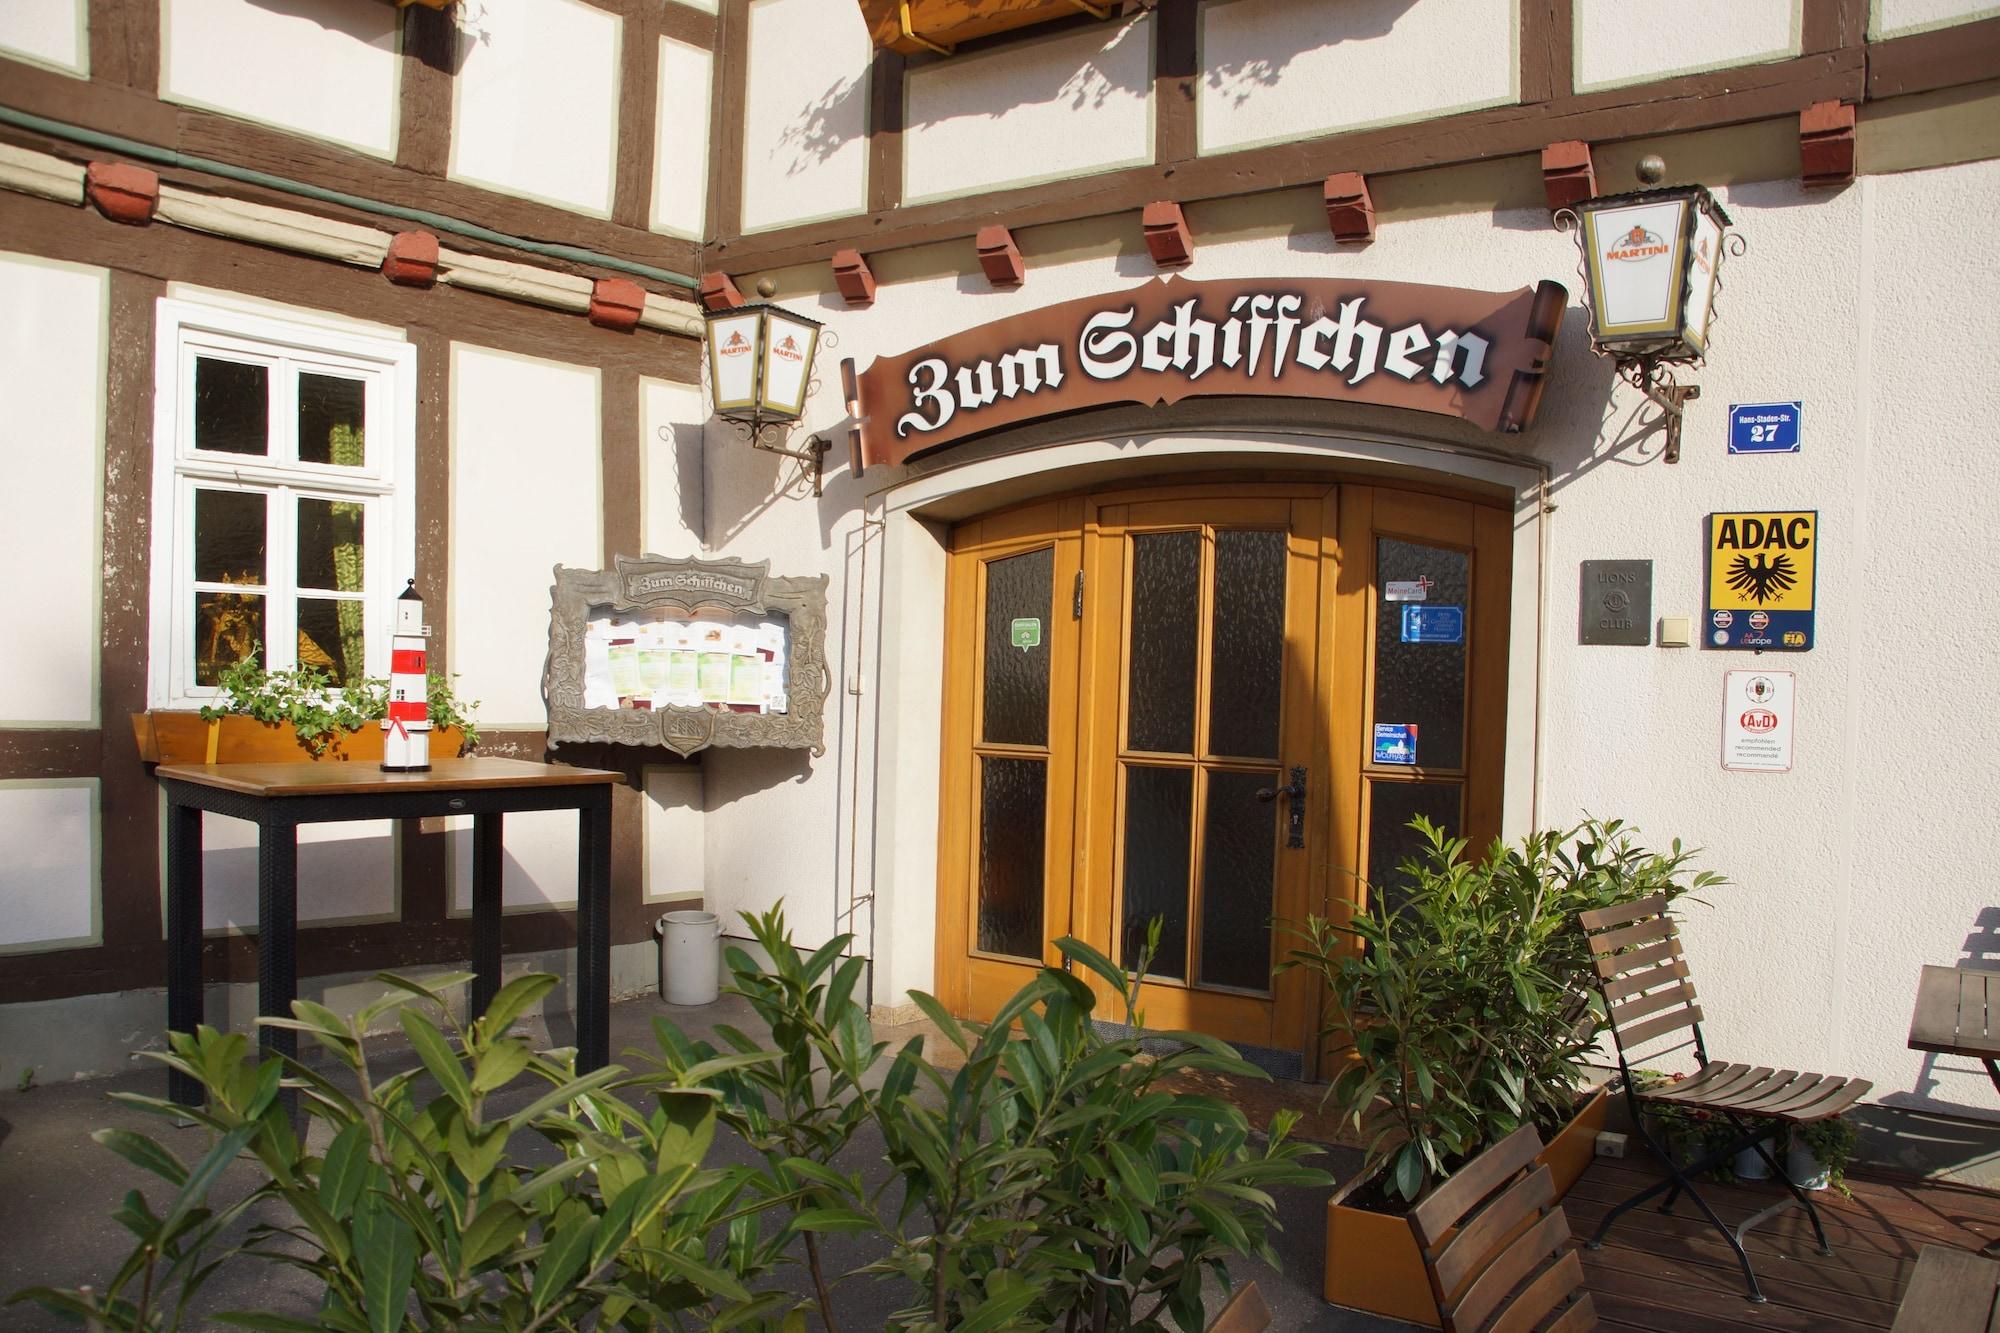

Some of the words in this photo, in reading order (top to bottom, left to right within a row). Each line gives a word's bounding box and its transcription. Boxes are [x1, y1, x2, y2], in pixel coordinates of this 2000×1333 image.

[1606, 245, 1669, 261] MARTINI
[720, 345, 752, 356] MARTINI
[772, 347, 803, 361] MARTINI
[897, 341, 1064, 438] Zum
[1078, 294, 1492, 389] Schiffchen
[1739, 414, 1791, 424] Hans-Staden-Str.
[1750, 424, 1779, 443] 27
[1717, 517, 1811, 550] ADAC
[639, 576, 673, 591] Zum
[675, 573, 745, 595] Schiffchen
[1597, 572, 1637, 584] LIONS
[1599, 618, 1633, 630] CLUB
[1783, 633, 1804, 645] FIA
[1747, 714, 1770, 728] AvD
